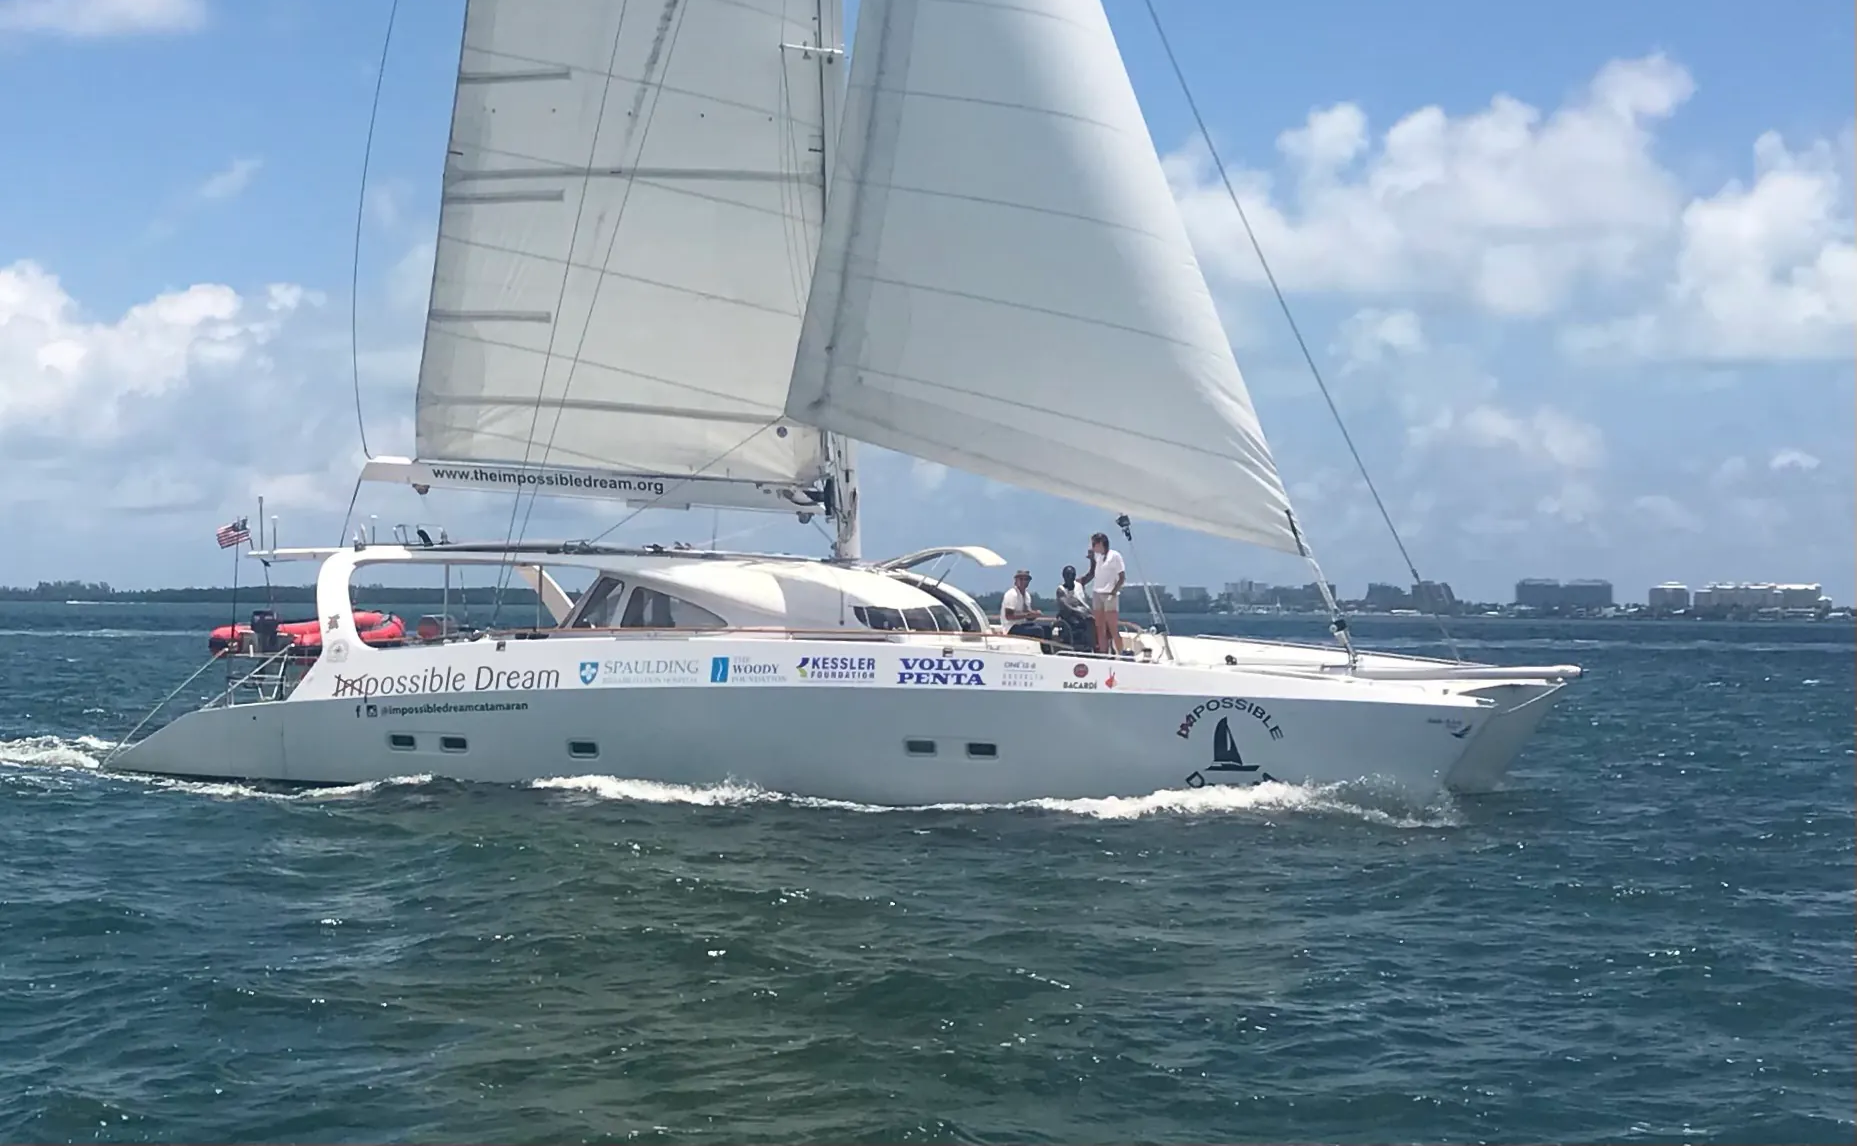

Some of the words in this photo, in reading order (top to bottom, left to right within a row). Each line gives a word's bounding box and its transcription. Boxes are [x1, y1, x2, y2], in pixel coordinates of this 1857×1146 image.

[433, 468, 664, 495] www.theimpossibledream.org
[604, 660, 699, 675] SPAULDING
[732, 664, 779, 674] WOODY
[812, 657, 875, 670] KESSLER
[899, 658, 984, 671] VOLVO
[475, 665, 560, 691] Dream
[811, 671, 875, 679] FOUNDATION
[897, 672, 986, 686] PENTA
[381, 702, 529, 716] @impossibledreamcatamaran
[1176, 697, 1284, 741] IMPOSSIBLE
